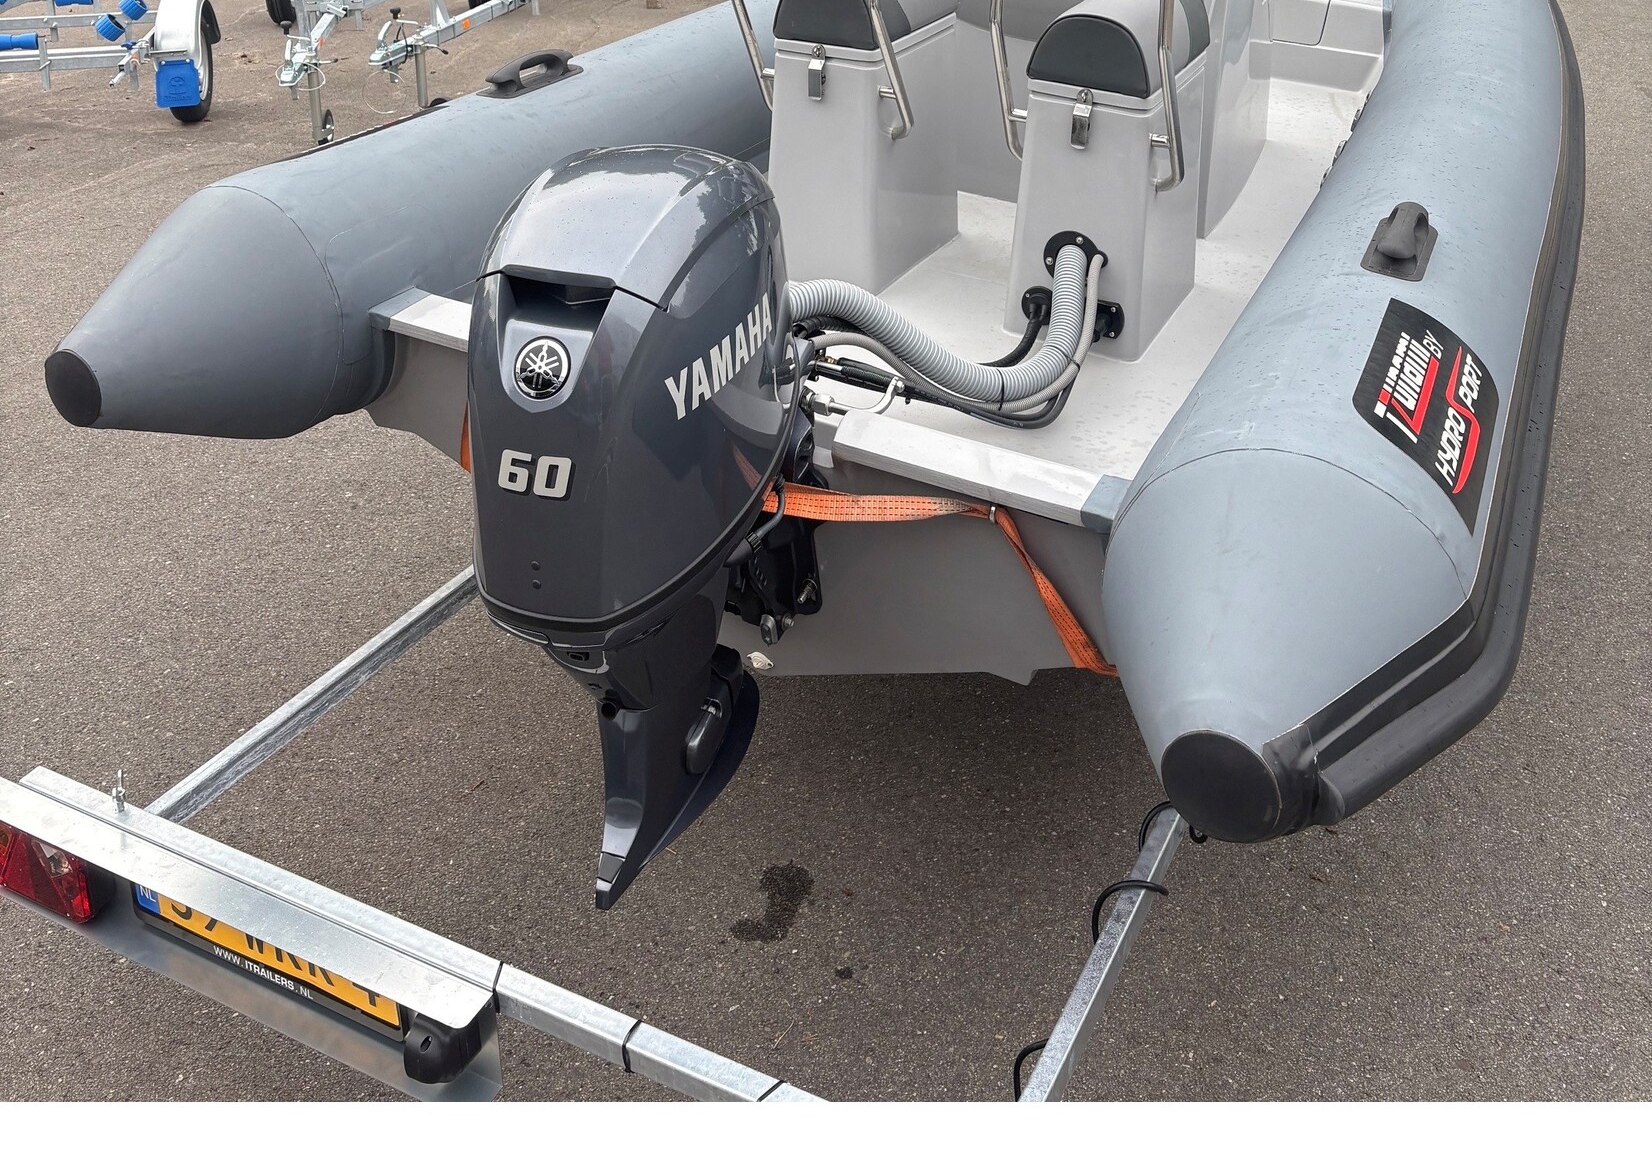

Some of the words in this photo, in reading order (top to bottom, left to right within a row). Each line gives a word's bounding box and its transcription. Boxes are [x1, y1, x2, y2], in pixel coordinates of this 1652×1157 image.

[664, 292, 773, 421] YAMAHA
[1422, 329, 1444, 360] BY
[497, 448, 575, 498] 60
[139, 884, 157, 903] NL
